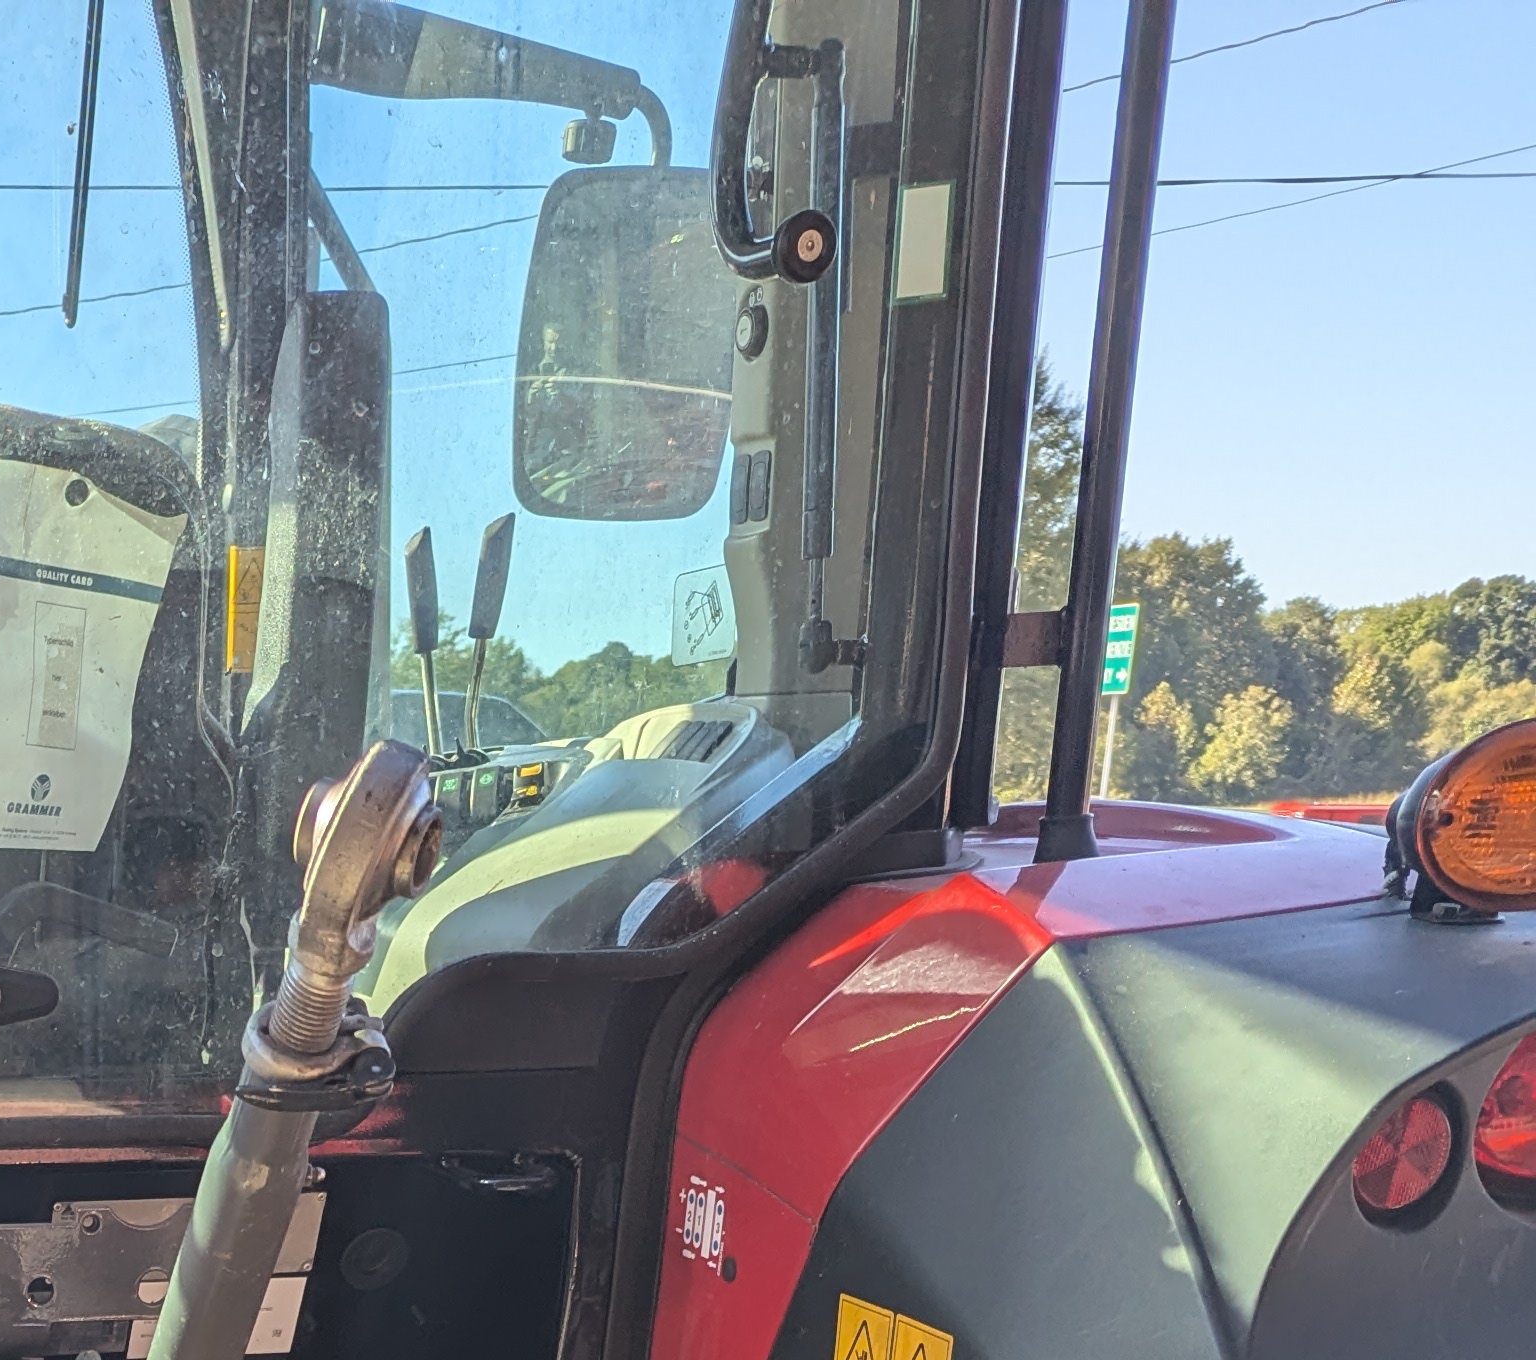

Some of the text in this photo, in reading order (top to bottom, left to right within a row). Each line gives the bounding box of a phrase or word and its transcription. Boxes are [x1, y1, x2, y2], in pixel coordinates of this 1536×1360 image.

[36, 569, 93, 586] QUALITY CARD
[7, 802, 62, 816] GRAMMER
